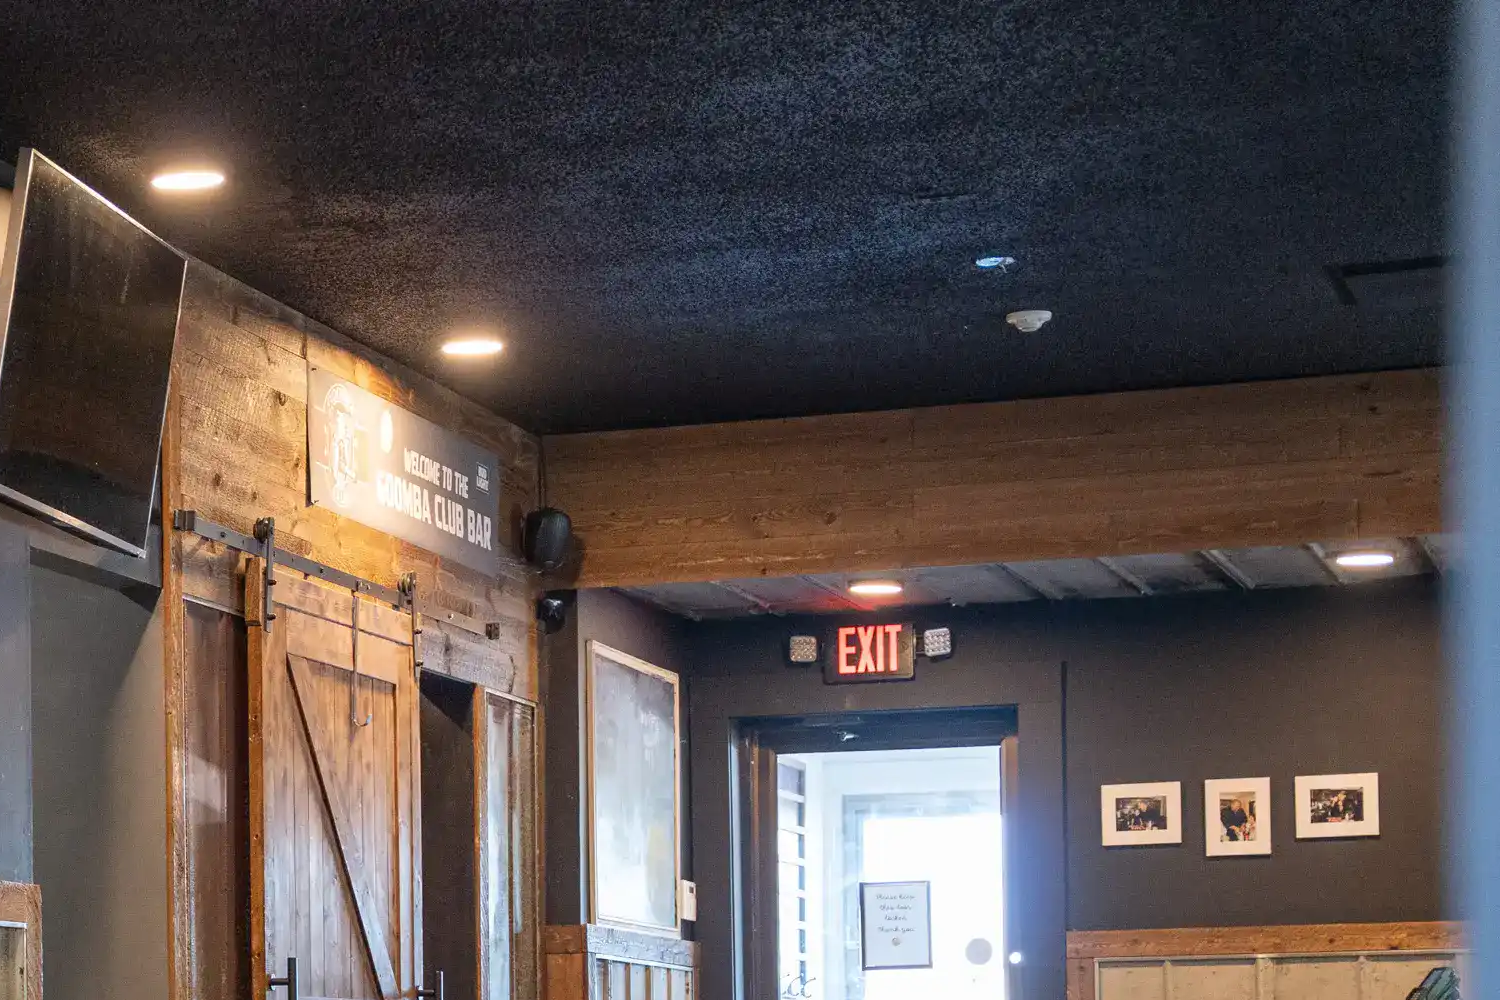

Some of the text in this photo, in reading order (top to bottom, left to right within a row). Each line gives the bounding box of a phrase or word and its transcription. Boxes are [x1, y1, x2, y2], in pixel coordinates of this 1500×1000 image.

[404, 447, 469, 499] WELCOME TO THE
[434, 493, 464, 539] CLUB
[467, 508, 492, 551] BAR
[838, 624, 902, 674] EXIT
